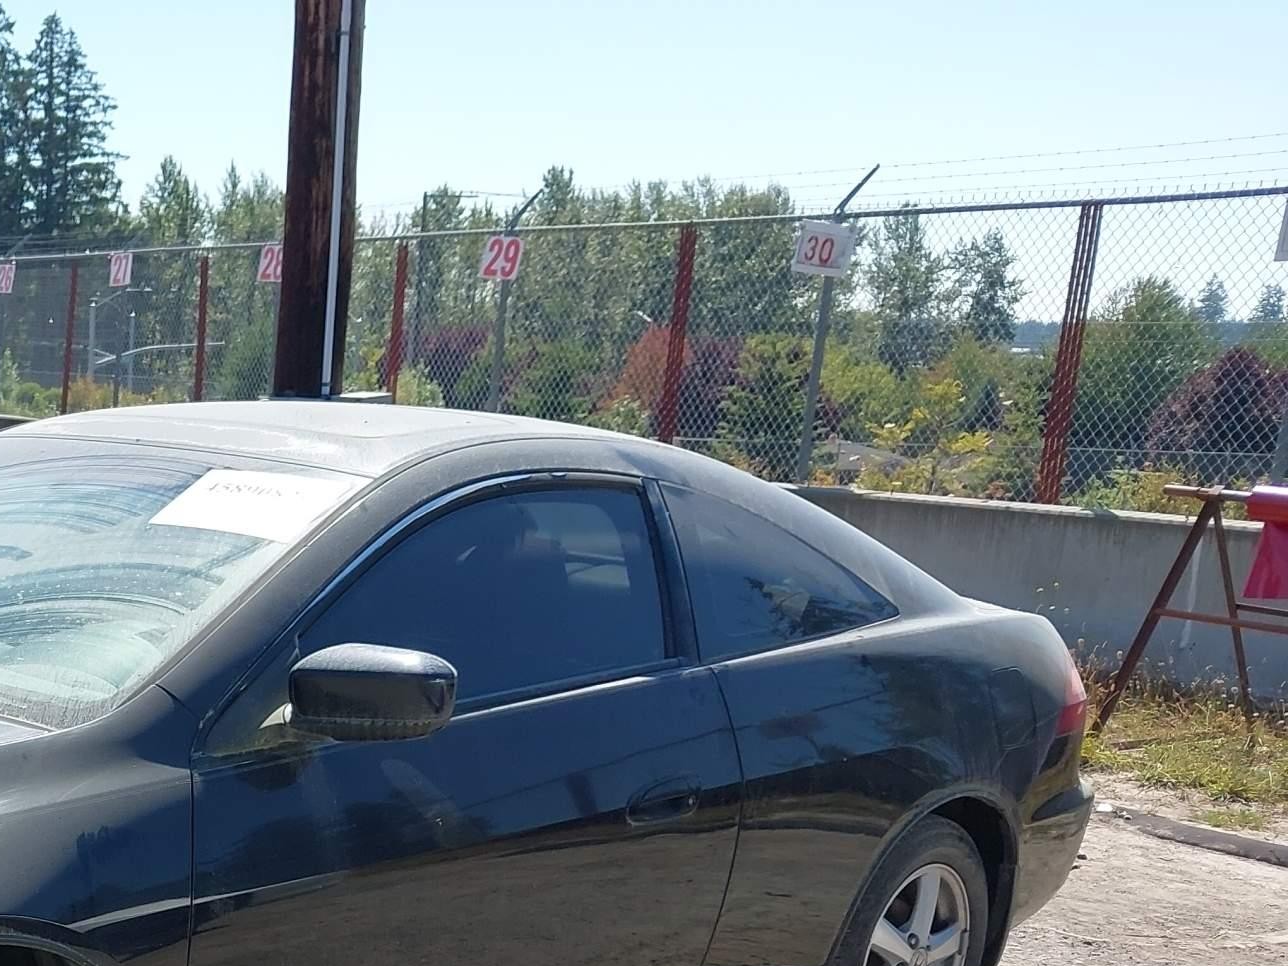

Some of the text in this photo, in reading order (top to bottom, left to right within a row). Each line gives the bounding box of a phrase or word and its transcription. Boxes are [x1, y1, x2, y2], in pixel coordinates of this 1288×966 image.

[483, 237, 520, 279] 29
[804, 234, 835, 264] 30
[112, 256, 131, 286] 27
